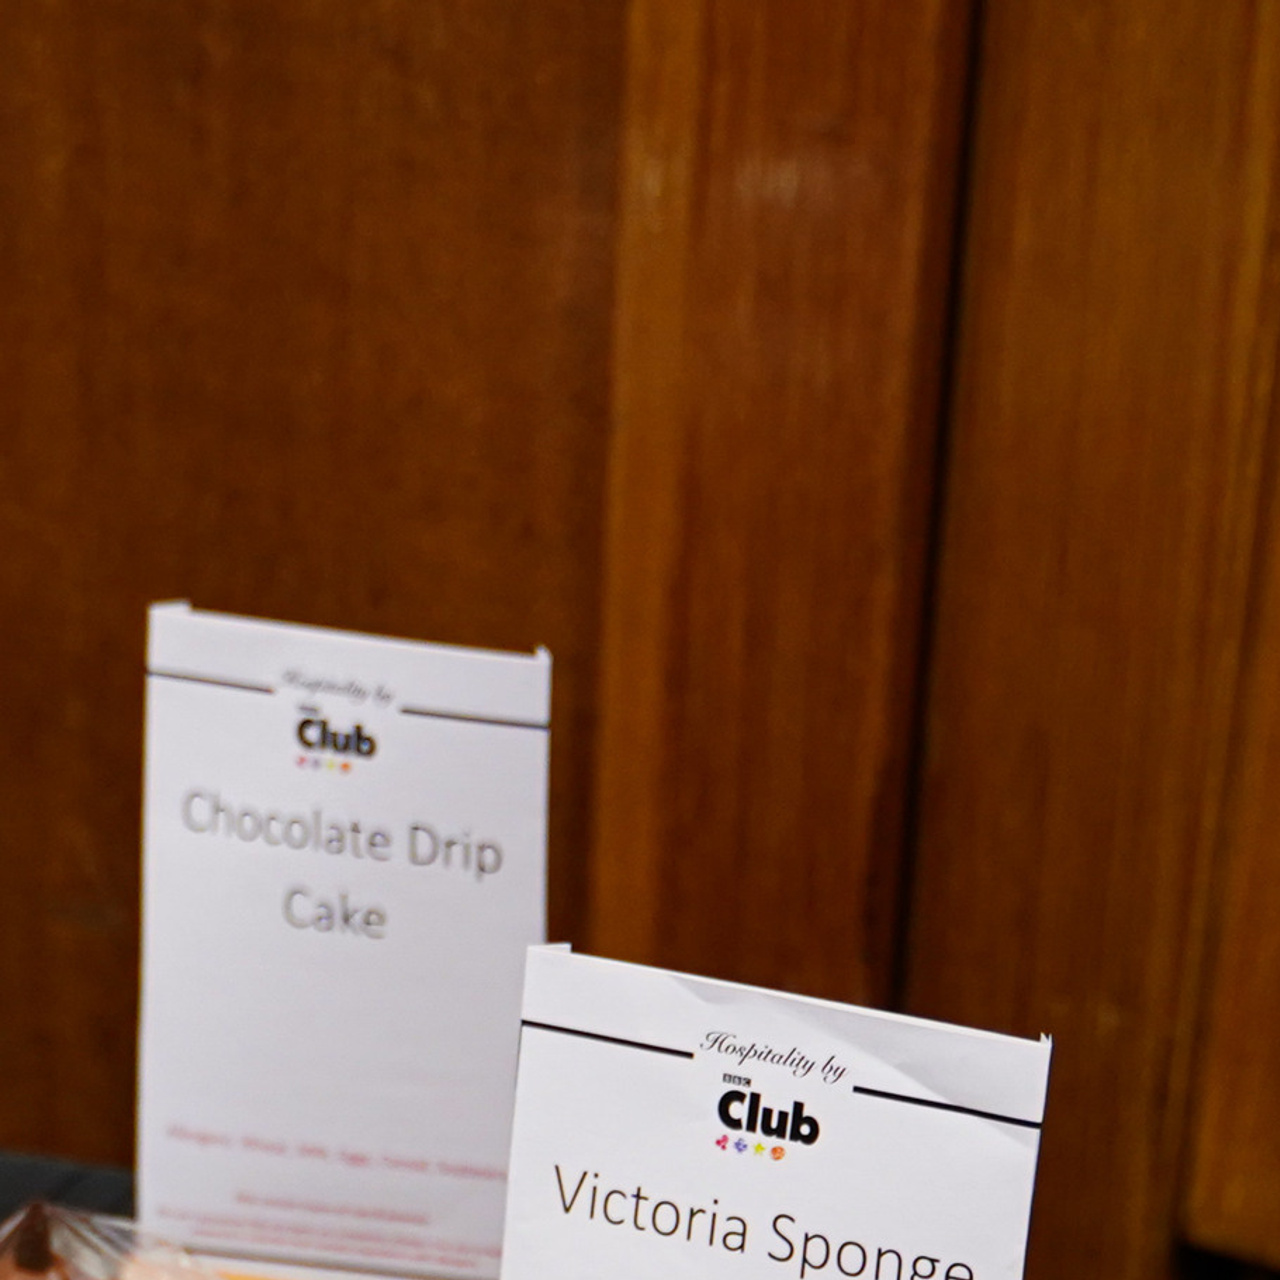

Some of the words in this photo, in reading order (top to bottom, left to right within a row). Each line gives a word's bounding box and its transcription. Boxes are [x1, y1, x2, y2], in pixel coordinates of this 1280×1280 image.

[297, 719, 376, 757] Club
[182, 793, 391, 861] Chocolate
[408, 824, 503, 881] Drip
[282, 889, 387, 939] Cake
[700, 1031, 816, 1077] Hospitality
[821, 1054, 849, 1085] by
[718, 1089, 820, 1145] Club
[554, 1164, 748, 1253] Victoria
